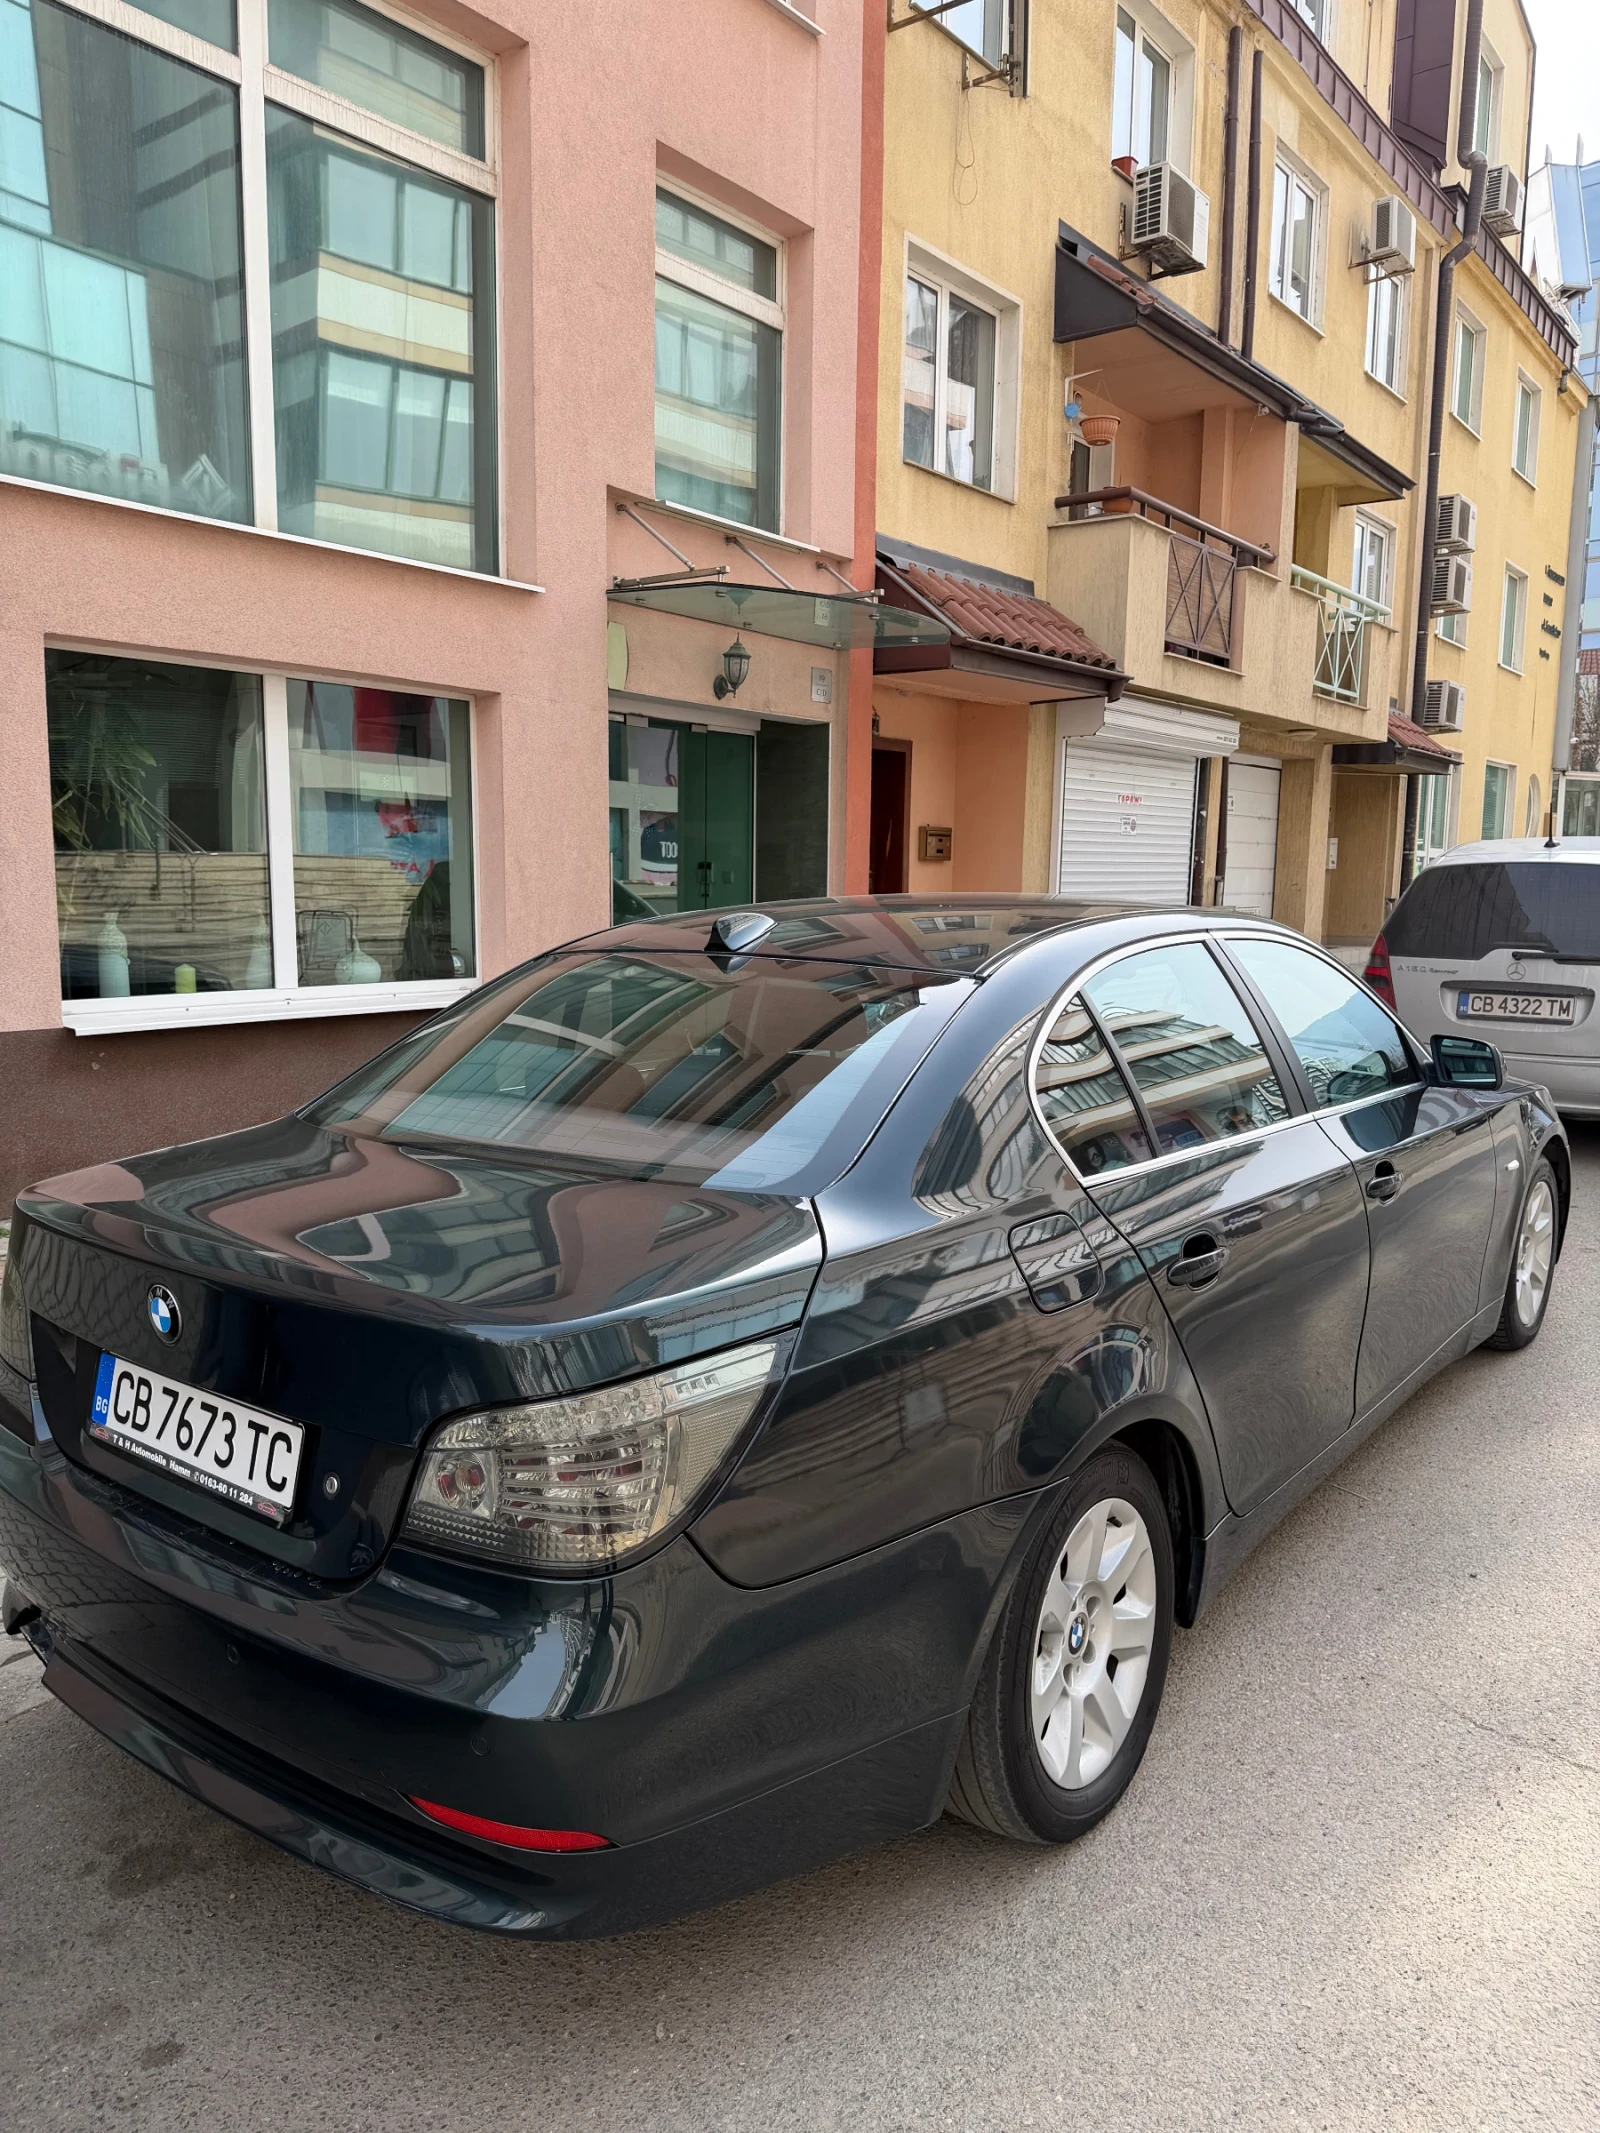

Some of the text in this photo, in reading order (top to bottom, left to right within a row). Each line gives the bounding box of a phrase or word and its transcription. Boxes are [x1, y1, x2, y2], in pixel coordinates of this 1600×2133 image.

[819, 674, 826, 683] 19
[816, 688, 828, 697] C/D
[1471, 996, 1572, 1018] CB 4322 TM
[149, 1287, 175, 1309] BMW
[95, 1396, 109, 1414] BG
[113, 1371, 293, 1493] CB 7673 TC
[113, 1434, 254, 1506] T & H Automobile Hamm 0163-60 11 284
